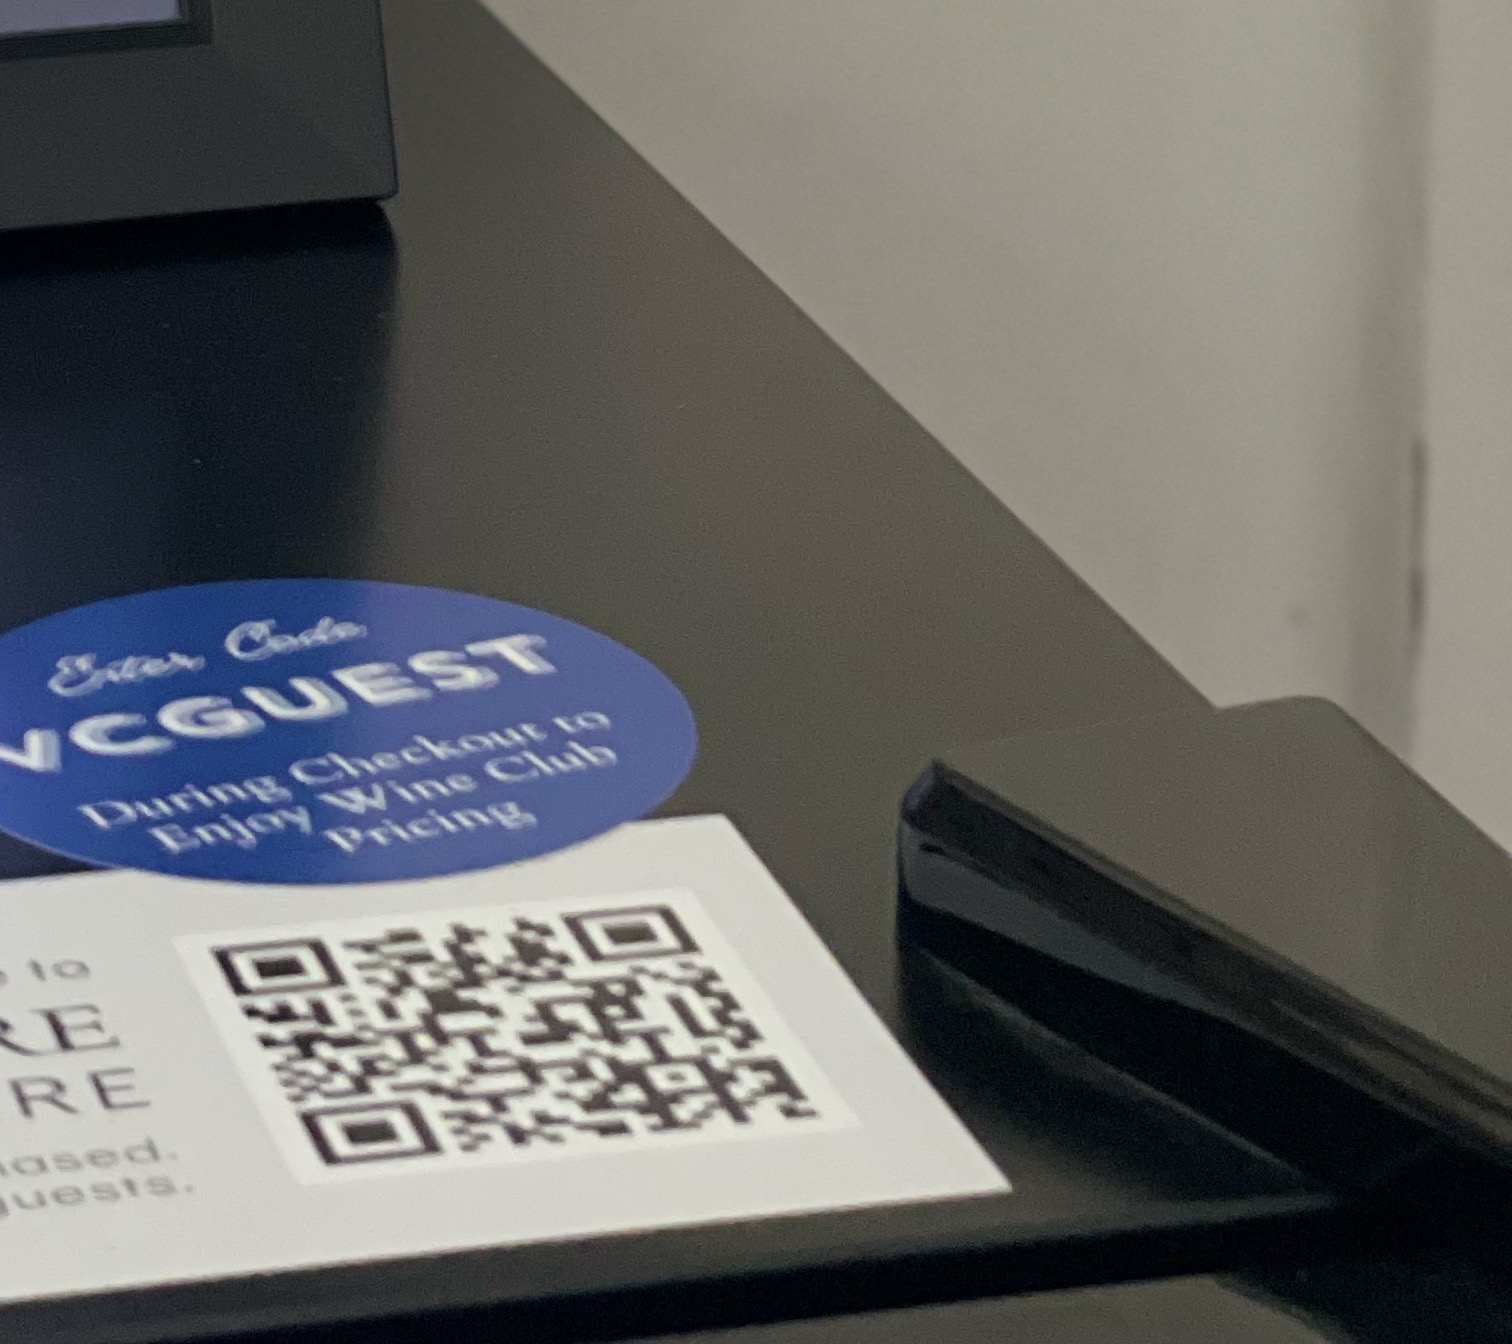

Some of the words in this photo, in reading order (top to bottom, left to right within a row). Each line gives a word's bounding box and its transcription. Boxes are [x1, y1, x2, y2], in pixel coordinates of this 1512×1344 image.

[47, 650, 205, 698] Enter
[225, 616, 368, 661] Code
[76, 774, 291, 830] During
[290, 725, 556, 787] Checkout
[555, 709, 611, 735] to
[149, 802, 312, 855] Enjoy
[323, 771, 478, 817] Wine
[484, 742, 618, 784] Club
[325, 799, 538, 855] Pricing
[30, 957, 92, 983] to
